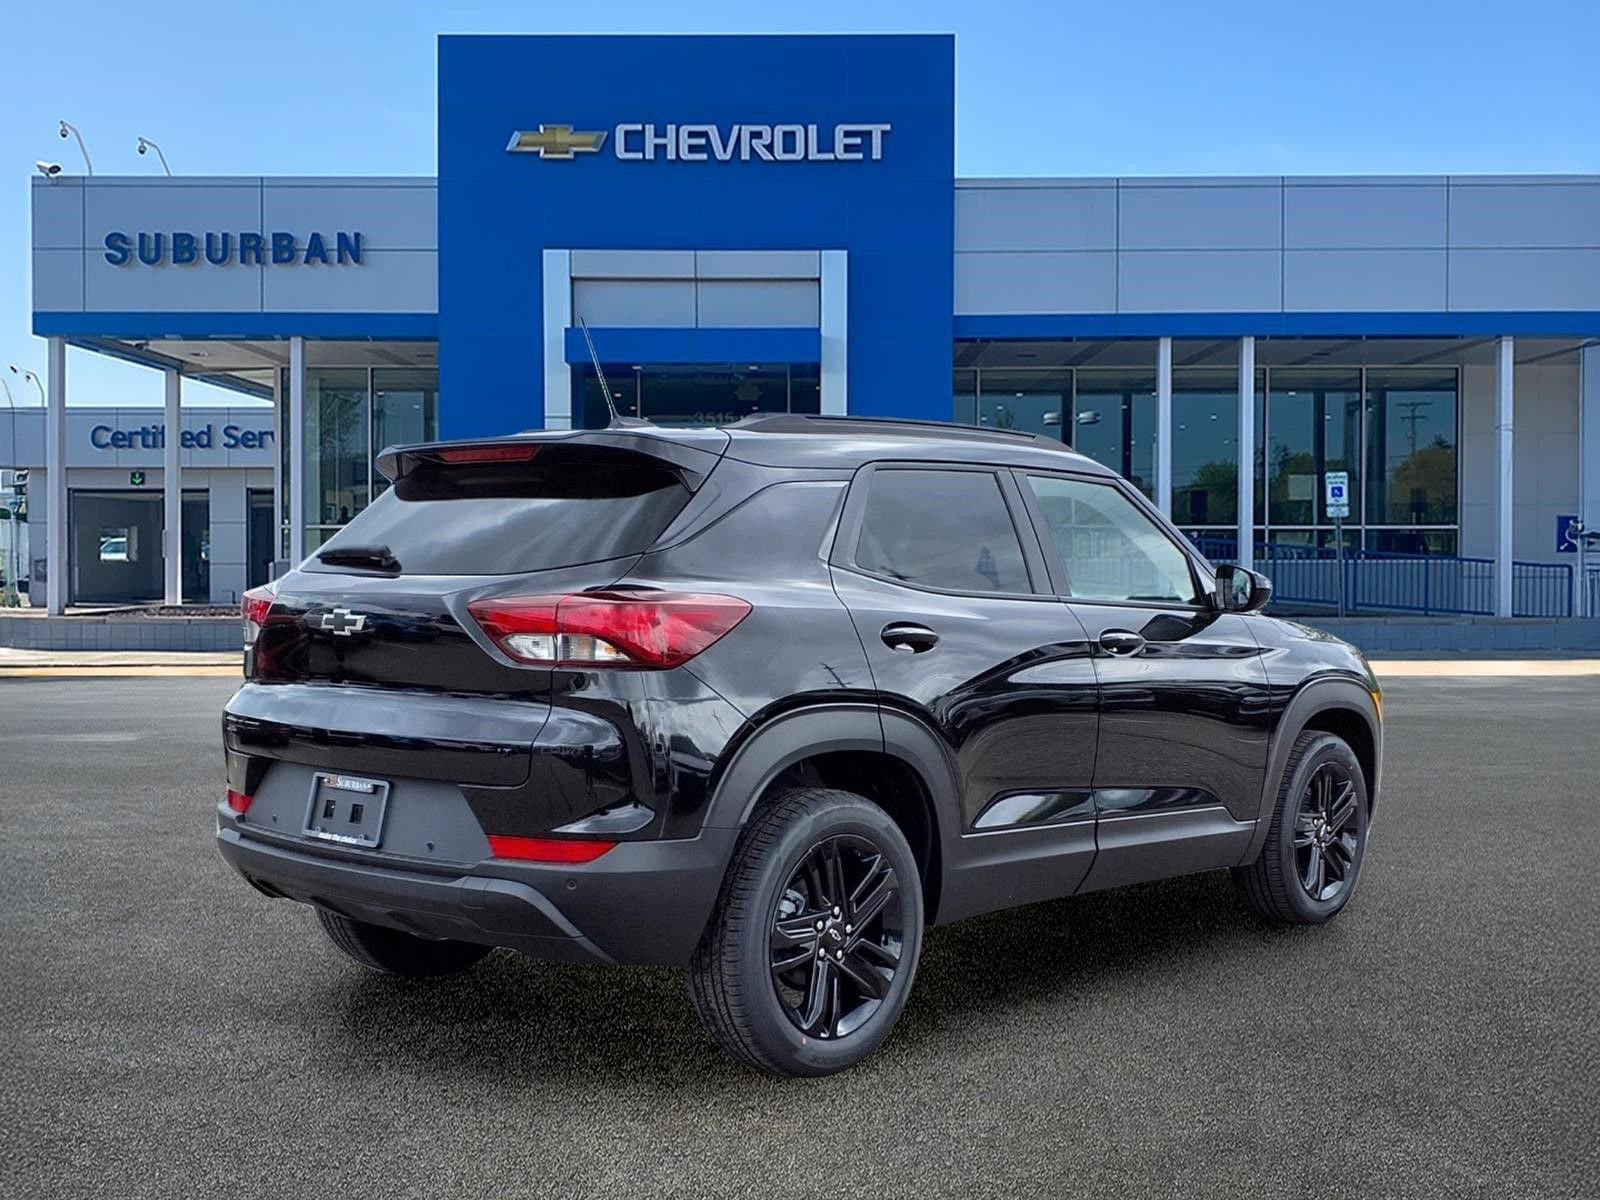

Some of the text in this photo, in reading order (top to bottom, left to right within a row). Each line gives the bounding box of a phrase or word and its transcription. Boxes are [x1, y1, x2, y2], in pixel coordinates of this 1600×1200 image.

[614, 123, 892, 161] CHEVROLET
[104, 231, 363, 266] SUBURBAN
[91, 424, 212, 449] Certifed
